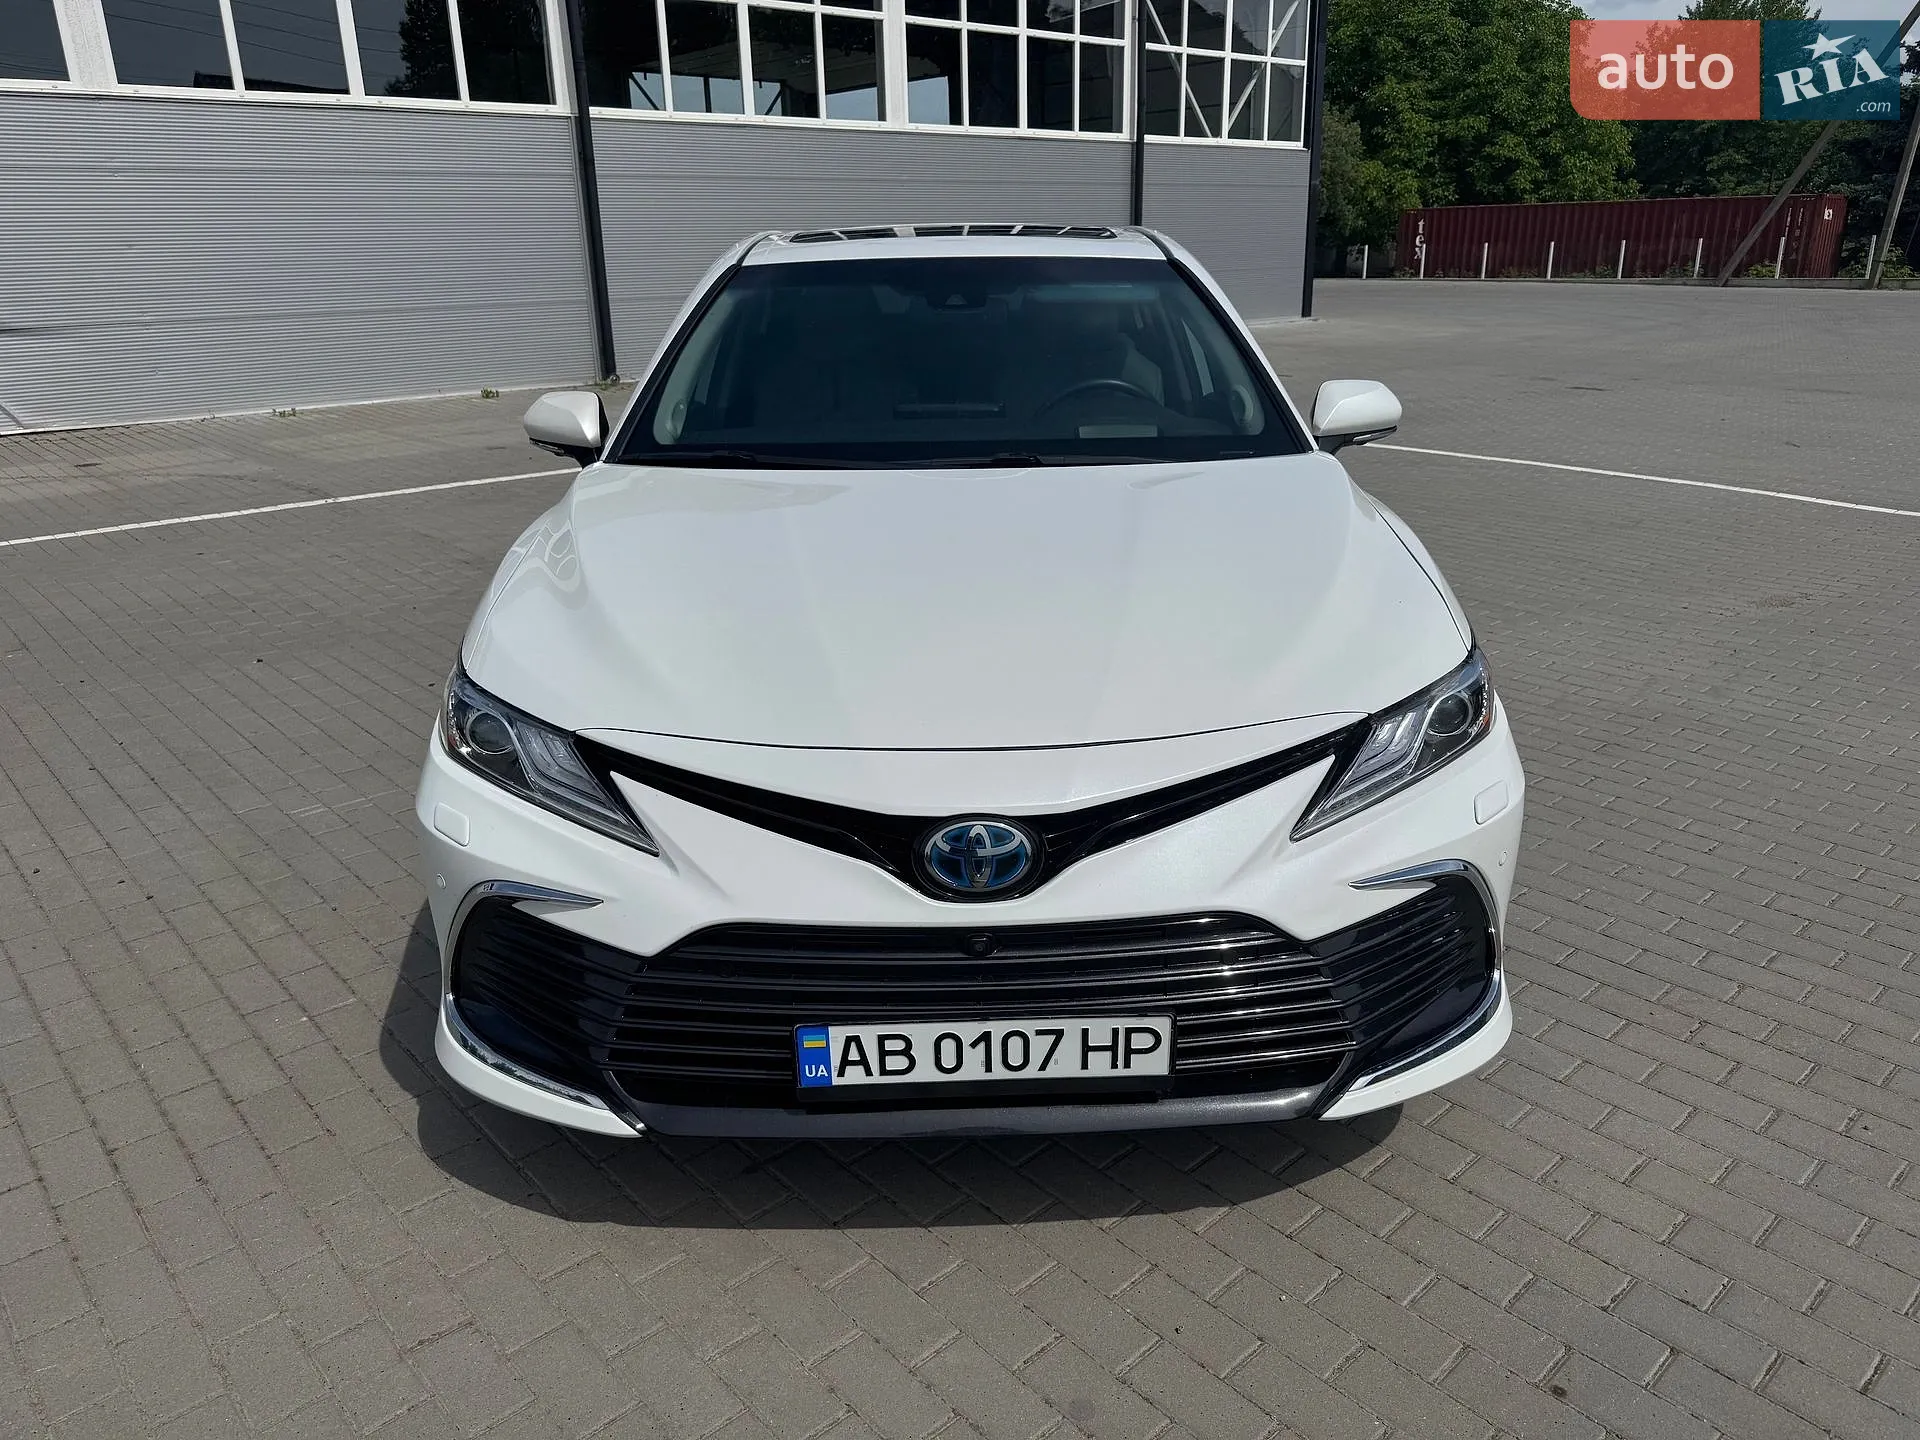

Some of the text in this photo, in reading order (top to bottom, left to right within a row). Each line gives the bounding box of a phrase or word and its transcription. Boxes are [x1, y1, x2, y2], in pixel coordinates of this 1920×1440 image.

[837, 1026, 1163, 1078] AB 0107 HP
[804, 1064, 829, 1078] UA
